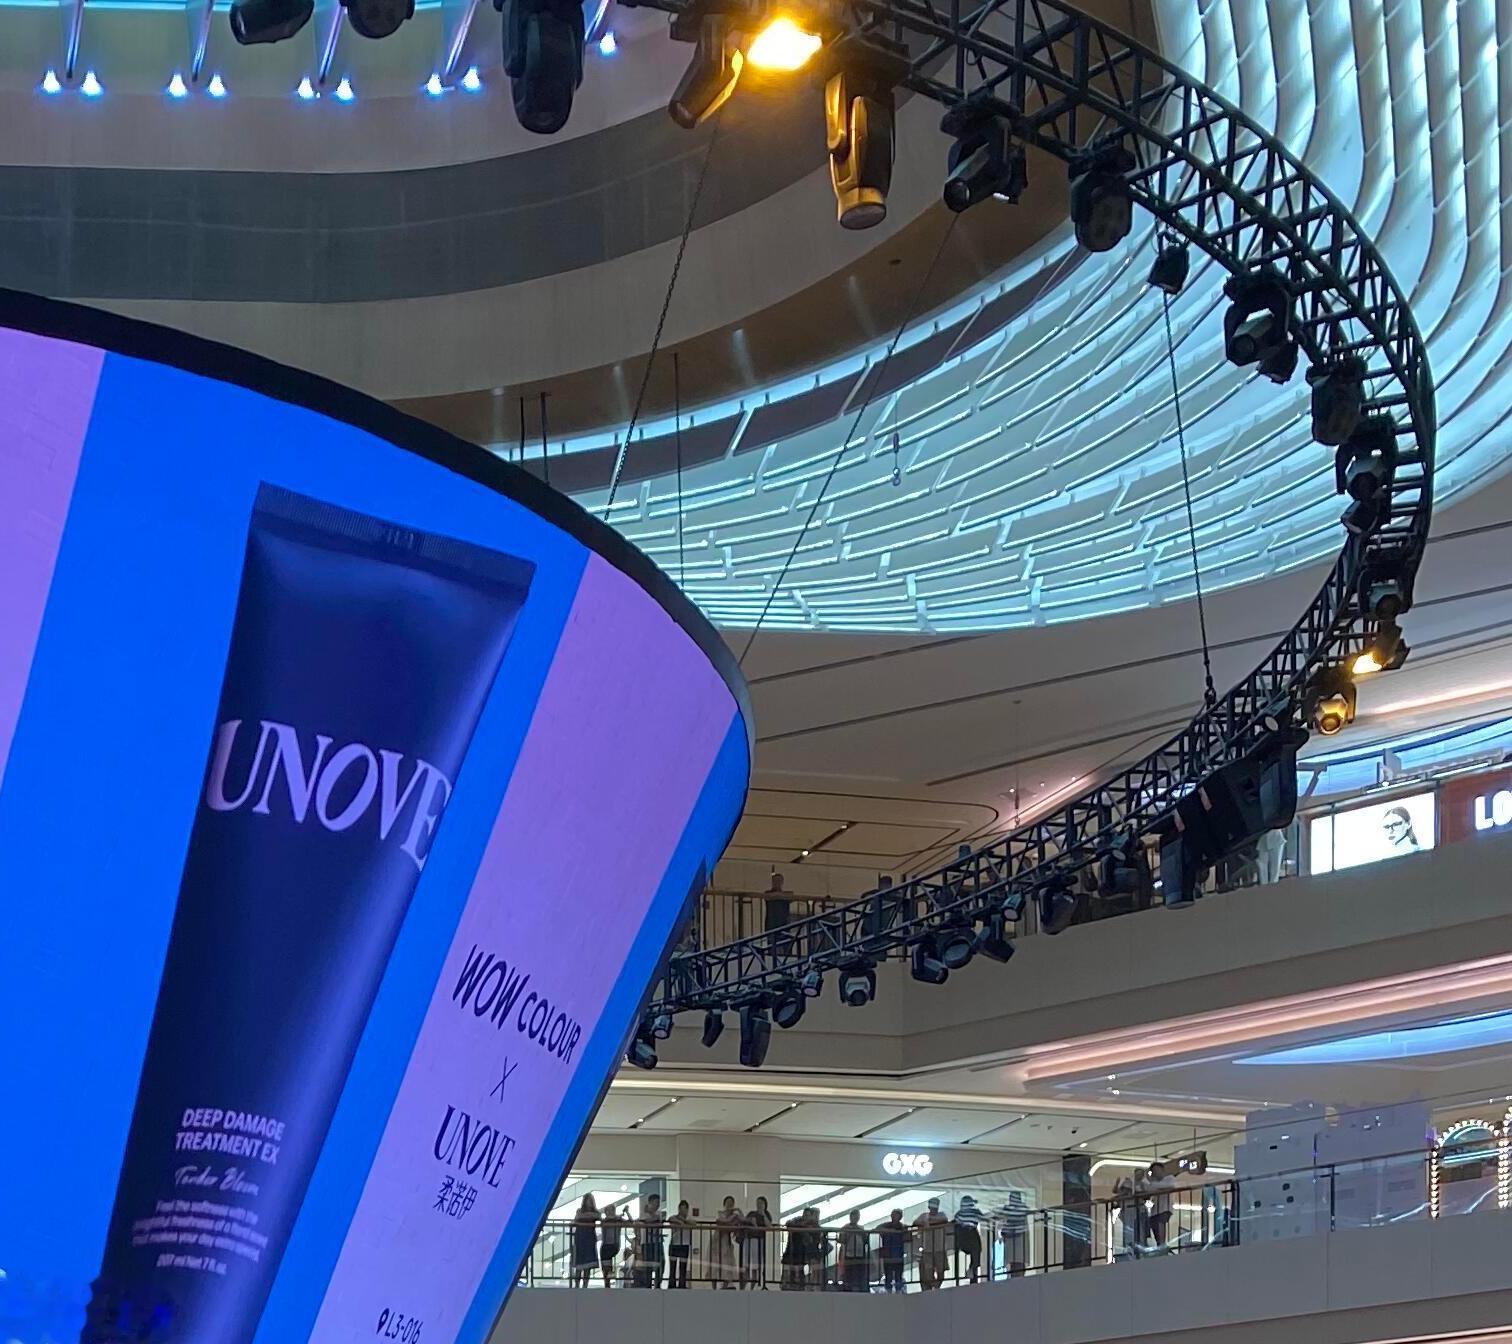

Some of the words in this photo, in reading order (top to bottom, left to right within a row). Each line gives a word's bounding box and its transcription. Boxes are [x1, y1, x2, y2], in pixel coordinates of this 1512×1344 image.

[205, 717, 453, 873] UNOVE
[452, 943, 530, 1031] WOW
[517, 989, 584, 1066] COLOUR
[175, 1132, 263, 1161] TREATMENT
[260, 1142, 281, 1166] EX
[182, 1108, 224, 1129] DEEP
[223, 1109, 287, 1143] DAMAGE
[432, 1105, 517, 1190] UNOVE
[882, 1151, 934, 1177] GXG
[433, 1174, 480, 1221] 柔诺伊
